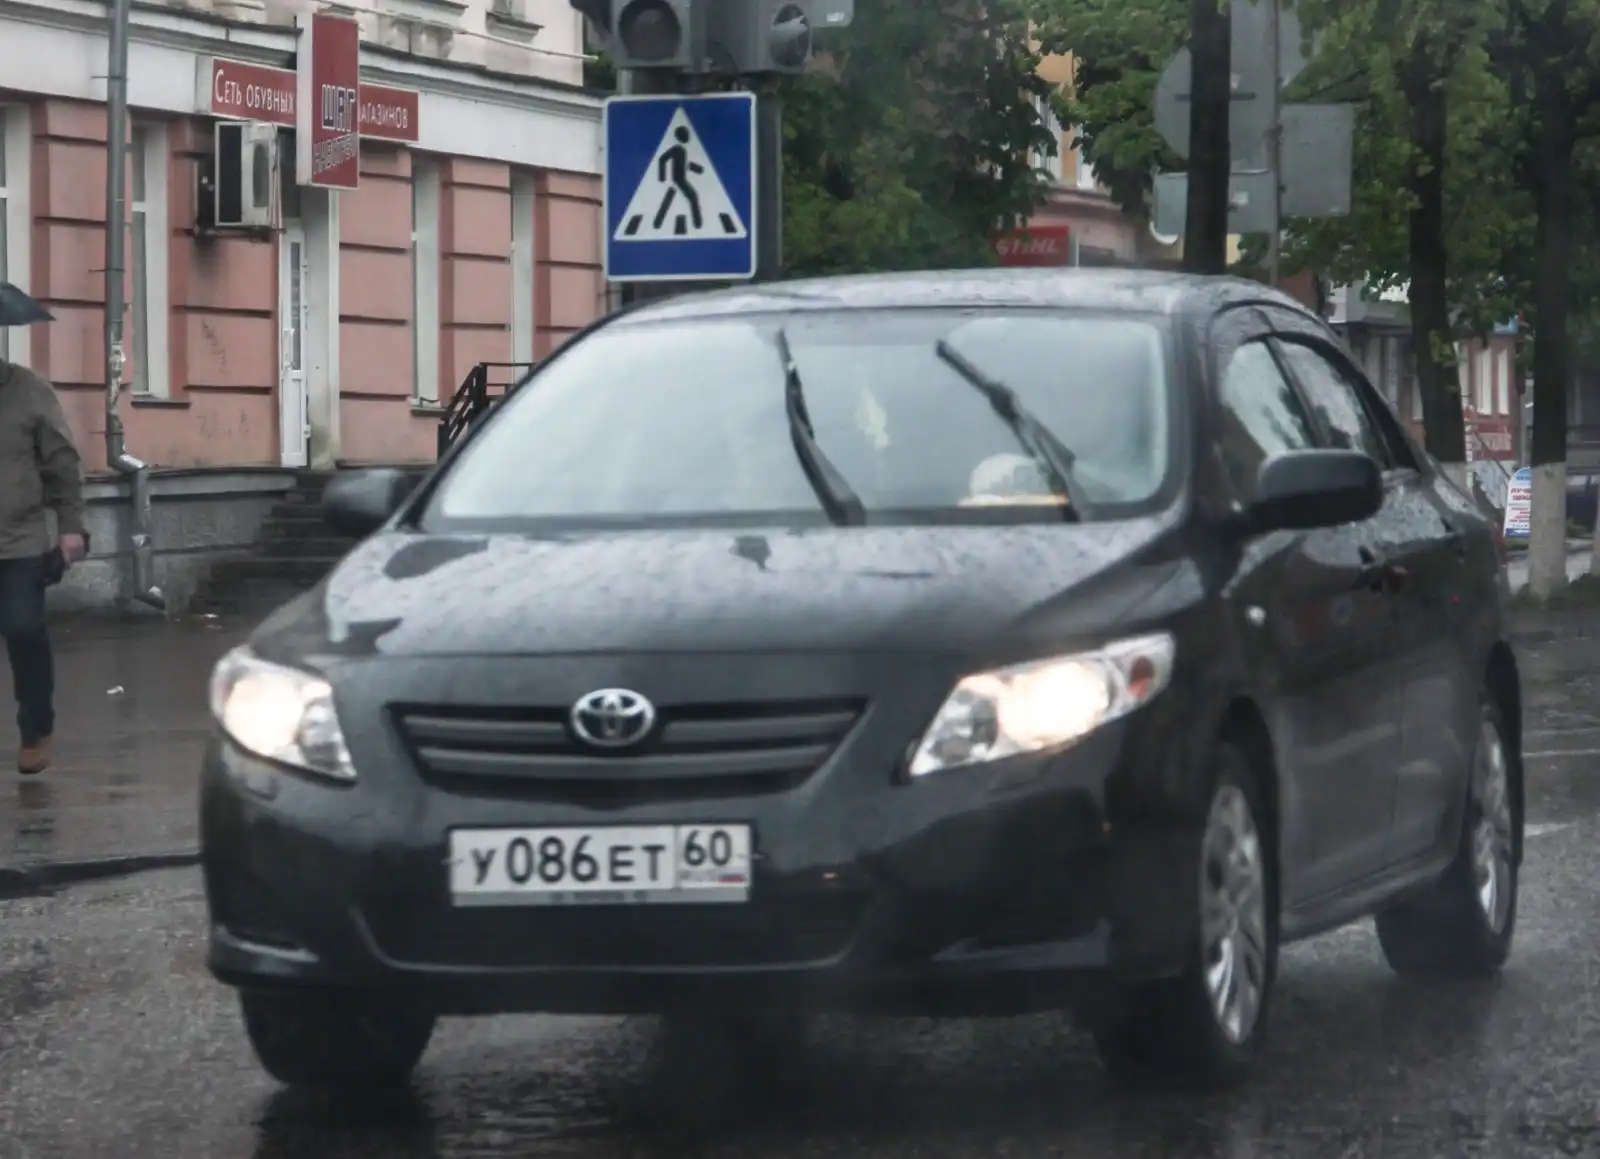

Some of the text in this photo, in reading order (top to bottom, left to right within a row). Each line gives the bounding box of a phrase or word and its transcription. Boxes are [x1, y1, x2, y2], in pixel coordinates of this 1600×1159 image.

[246, 84, 295, 114] ОБУВНЫХ
[359, 102, 409, 129] АГАЗИНОВ
[321, 83, 356, 132] ШАГ
[684, 829, 732, 867] 60
